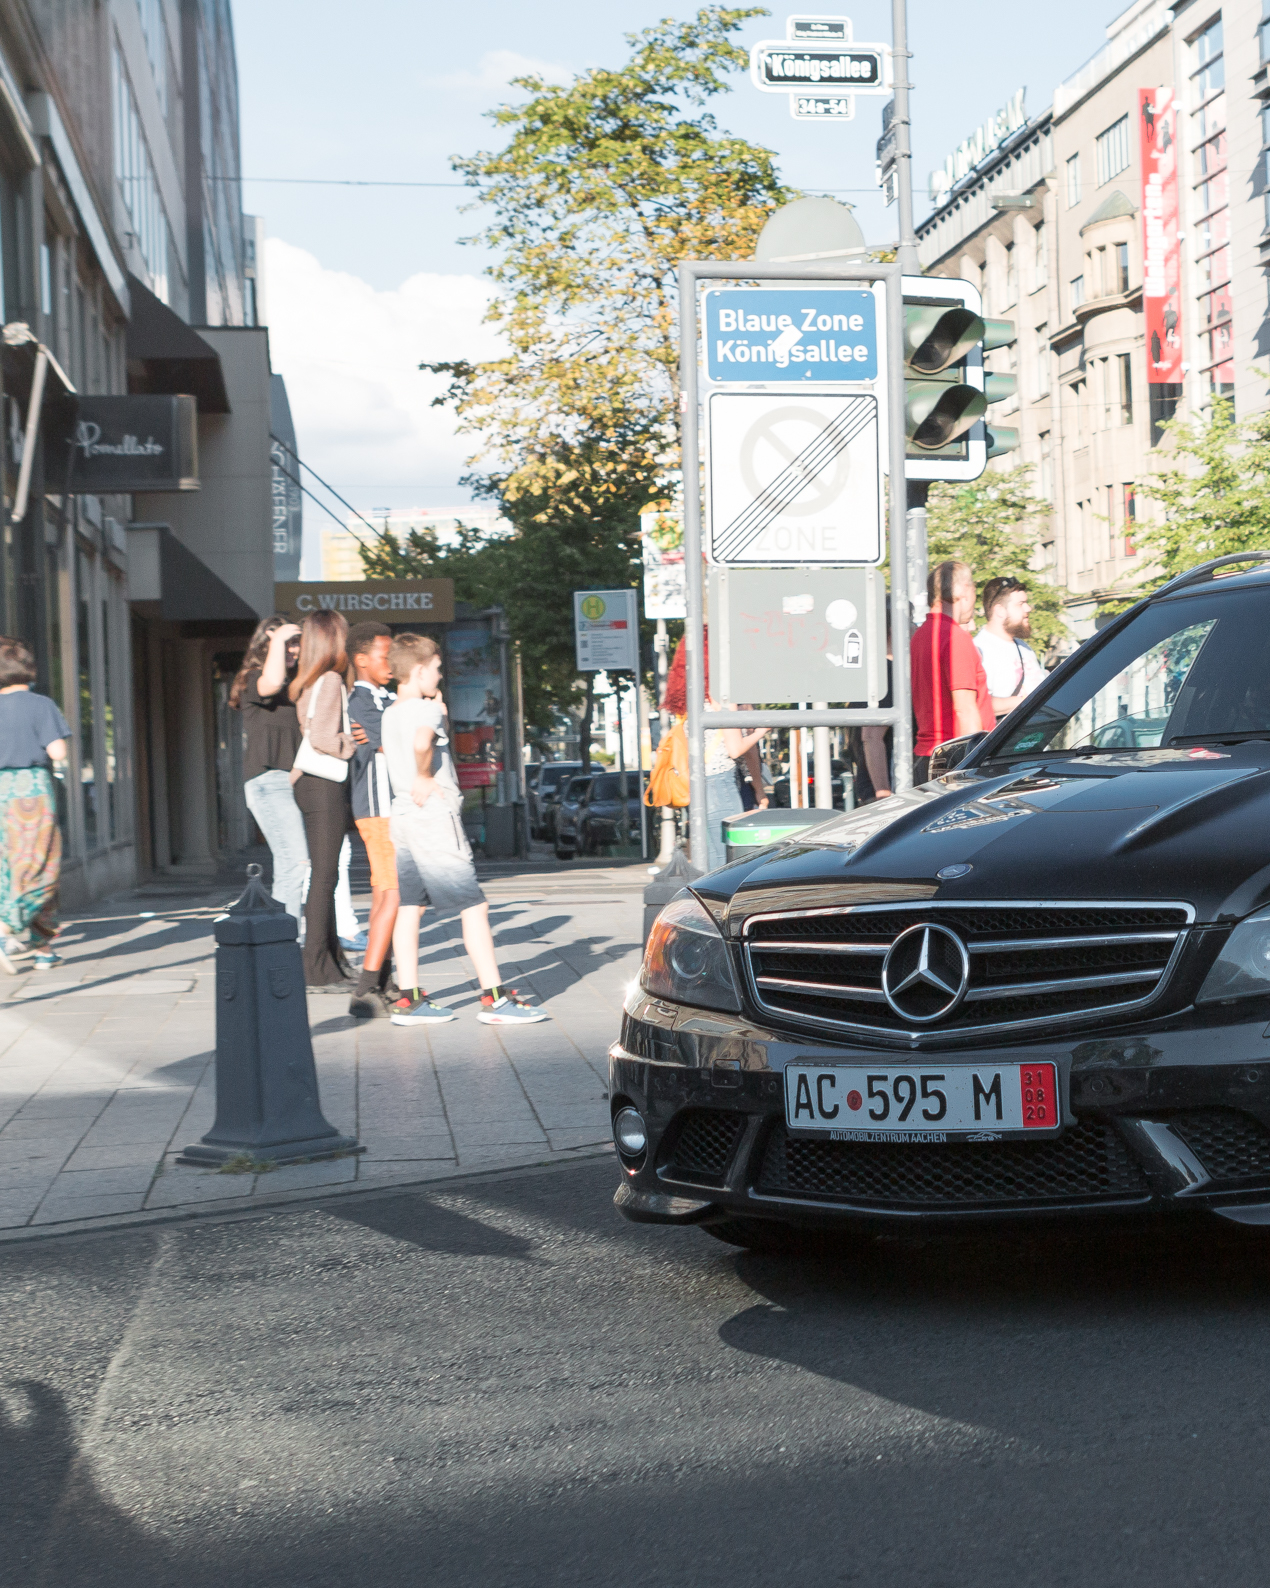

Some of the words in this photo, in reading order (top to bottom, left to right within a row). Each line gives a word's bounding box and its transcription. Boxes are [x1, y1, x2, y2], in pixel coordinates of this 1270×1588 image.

[771, 53, 872, 81] Königsallee
[798, 98, 848, 114] 34a-54
[719, 309, 792, 331] Blaue
[801, 309, 864, 331] Zone
[716, 340, 869, 368] Königsallee
[756, 526, 838, 551] ZONE
[1024, 1070, 1043, 1085] 31
[794, 1072, 840, 1120] AC
[866, 1074, 947, 1122] 595
[971, 1072, 1003, 1121] M
[1025, 1087, 1046, 1103] 08
[1026, 1104, 1047, 1120] 20
[830, 1131, 910, 1143] AUTOMOBILZENTRUM
[910, 1132, 947, 1143] AACHEN
